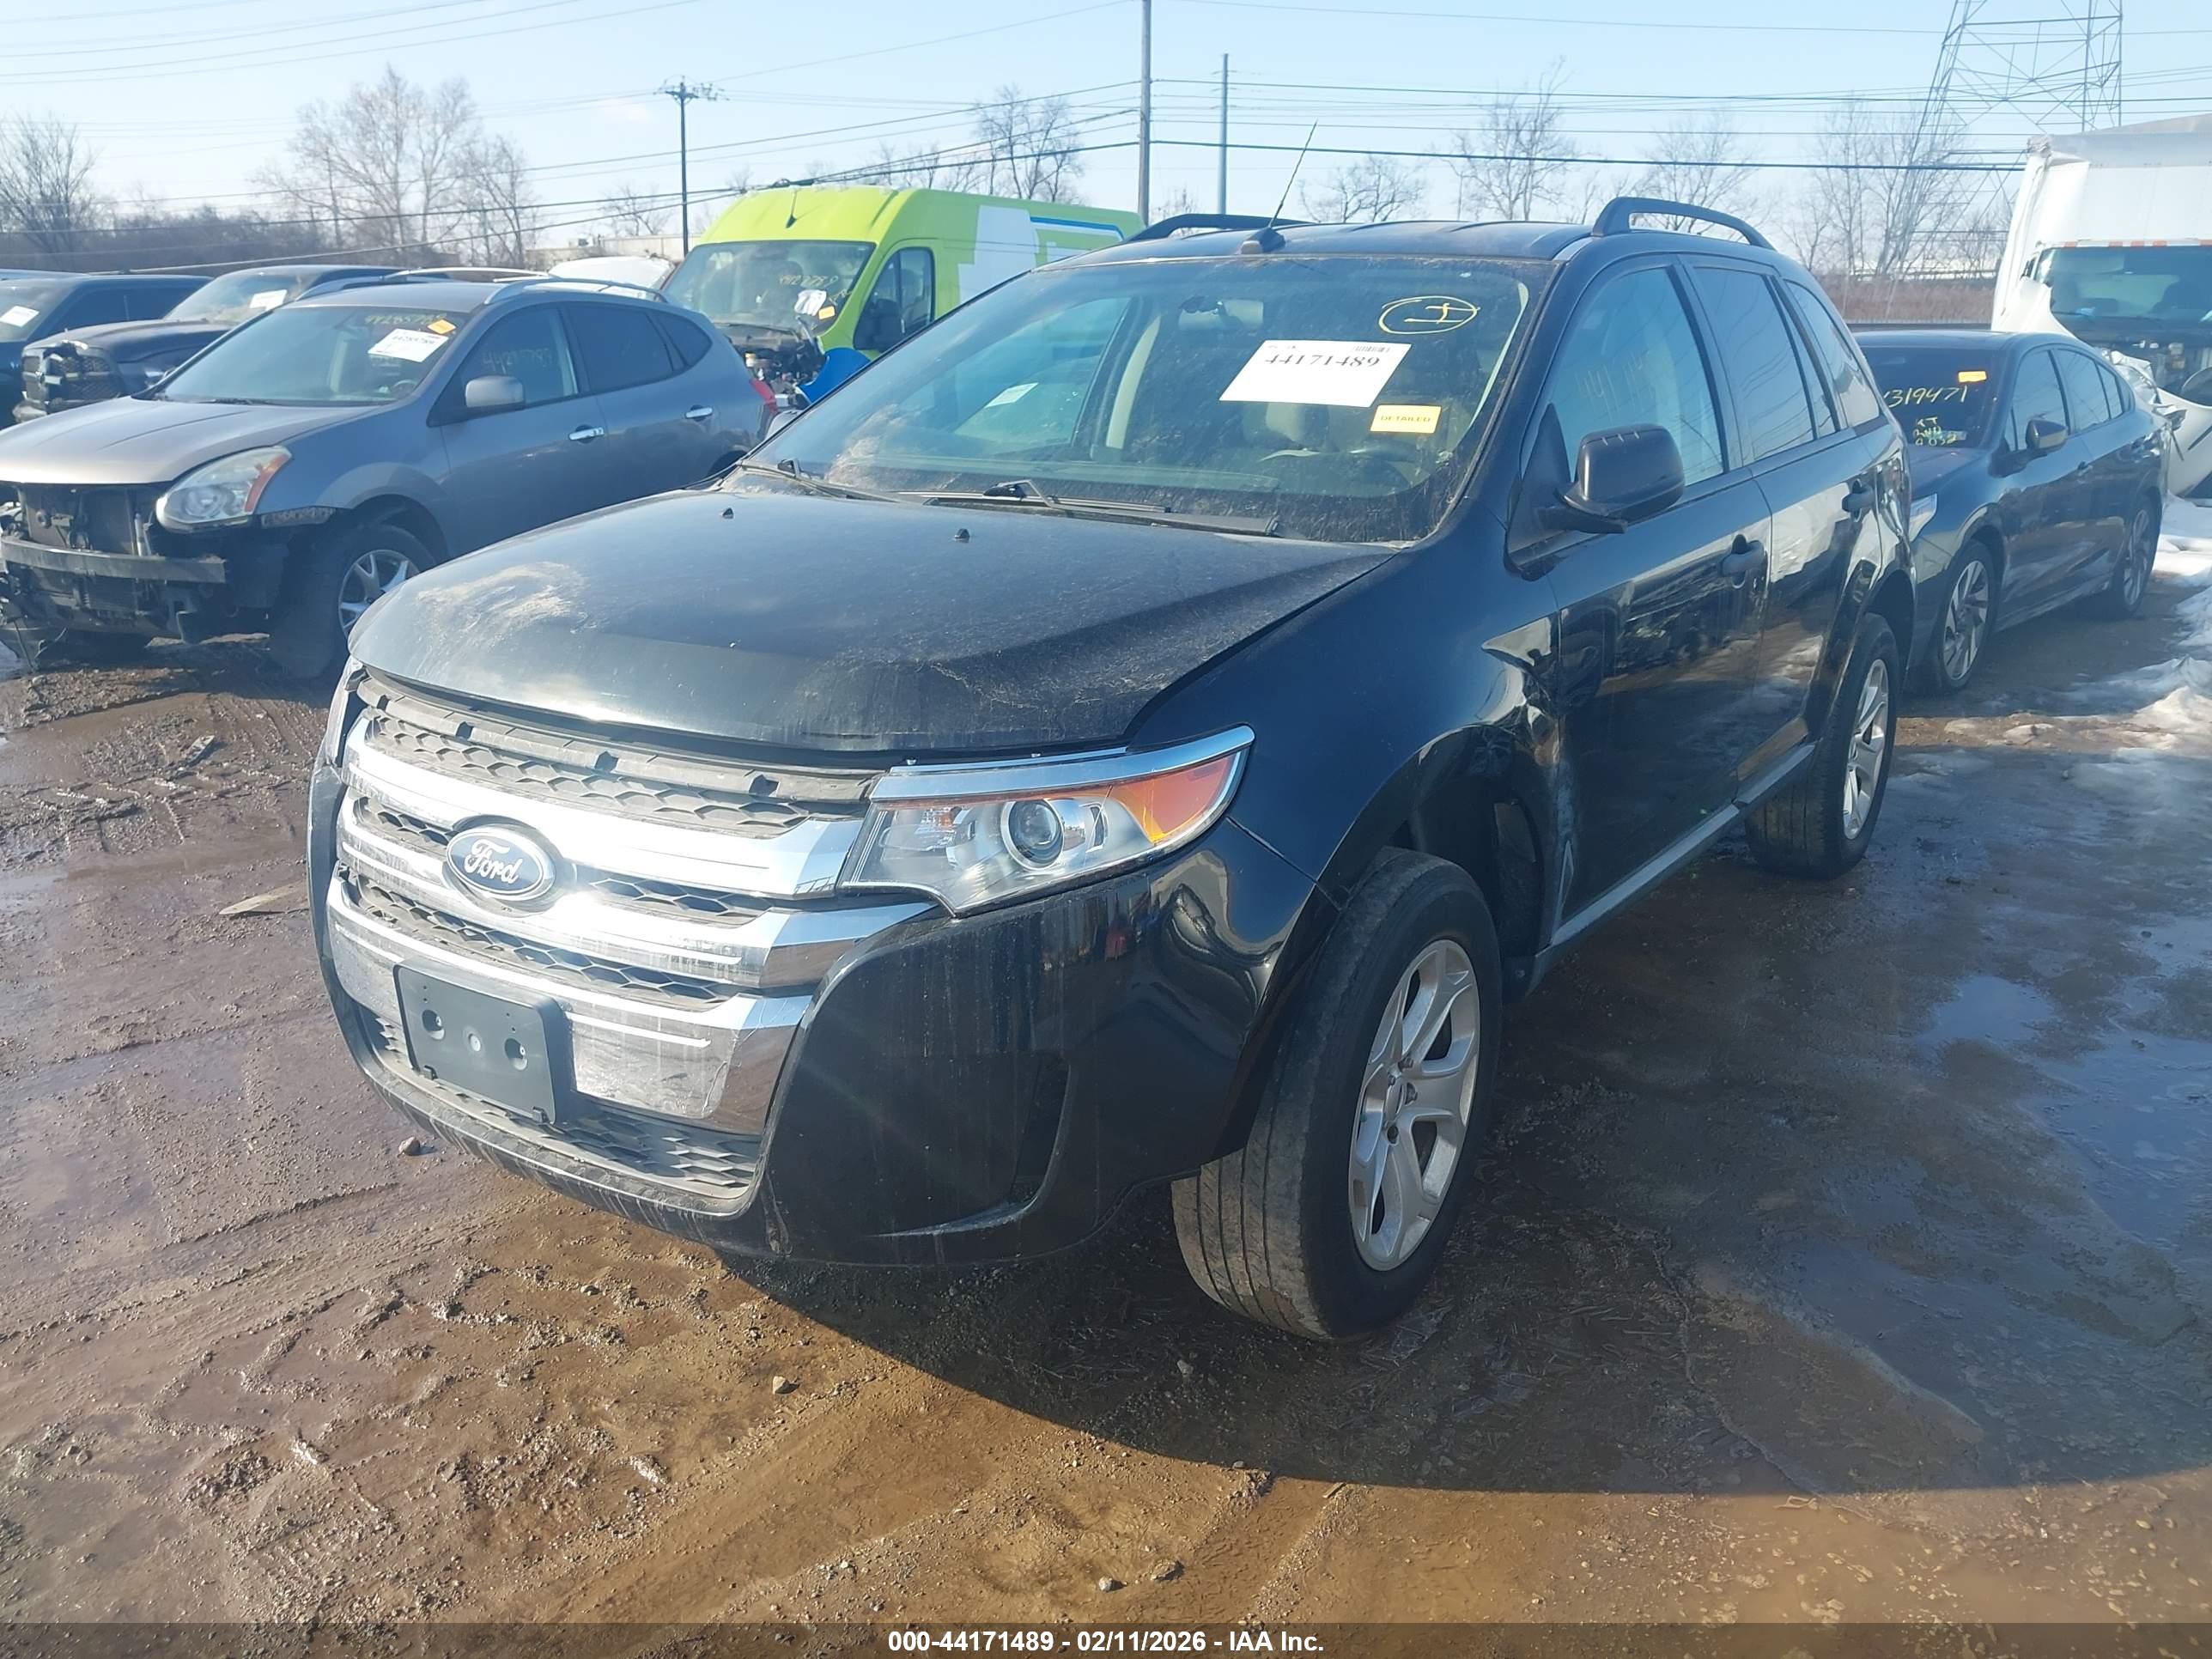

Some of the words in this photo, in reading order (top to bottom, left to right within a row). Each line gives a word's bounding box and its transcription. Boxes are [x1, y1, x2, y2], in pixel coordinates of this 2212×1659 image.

[1265, 354, 1381, 368] 44171489
[1380, 414, 1431, 422] DETAILED
[464, 838, 524, 884] Ford
